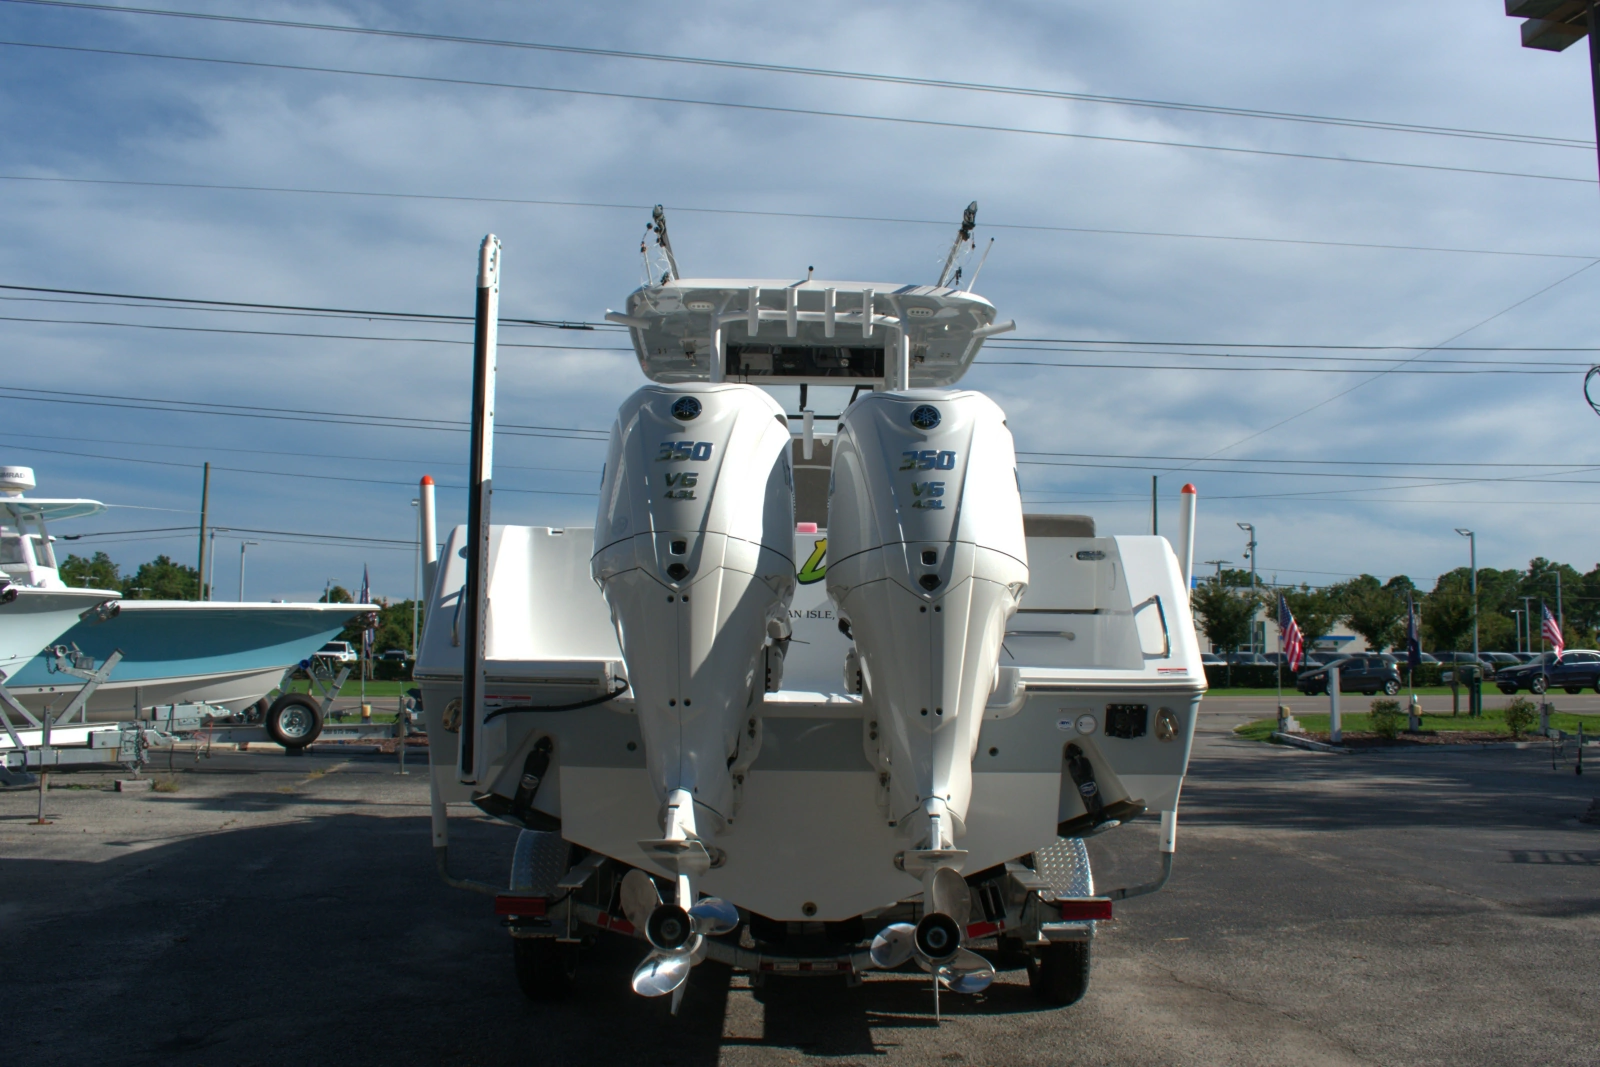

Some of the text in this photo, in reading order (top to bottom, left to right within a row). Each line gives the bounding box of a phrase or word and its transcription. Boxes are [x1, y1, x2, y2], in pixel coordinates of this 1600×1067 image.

[655, 441, 714, 462] 350
[899, 450, 957, 471] 350
[665, 472, 699, 487] V6
[911, 481, 946, 497] V6
[806, 610, 835, 620] ISLE,
